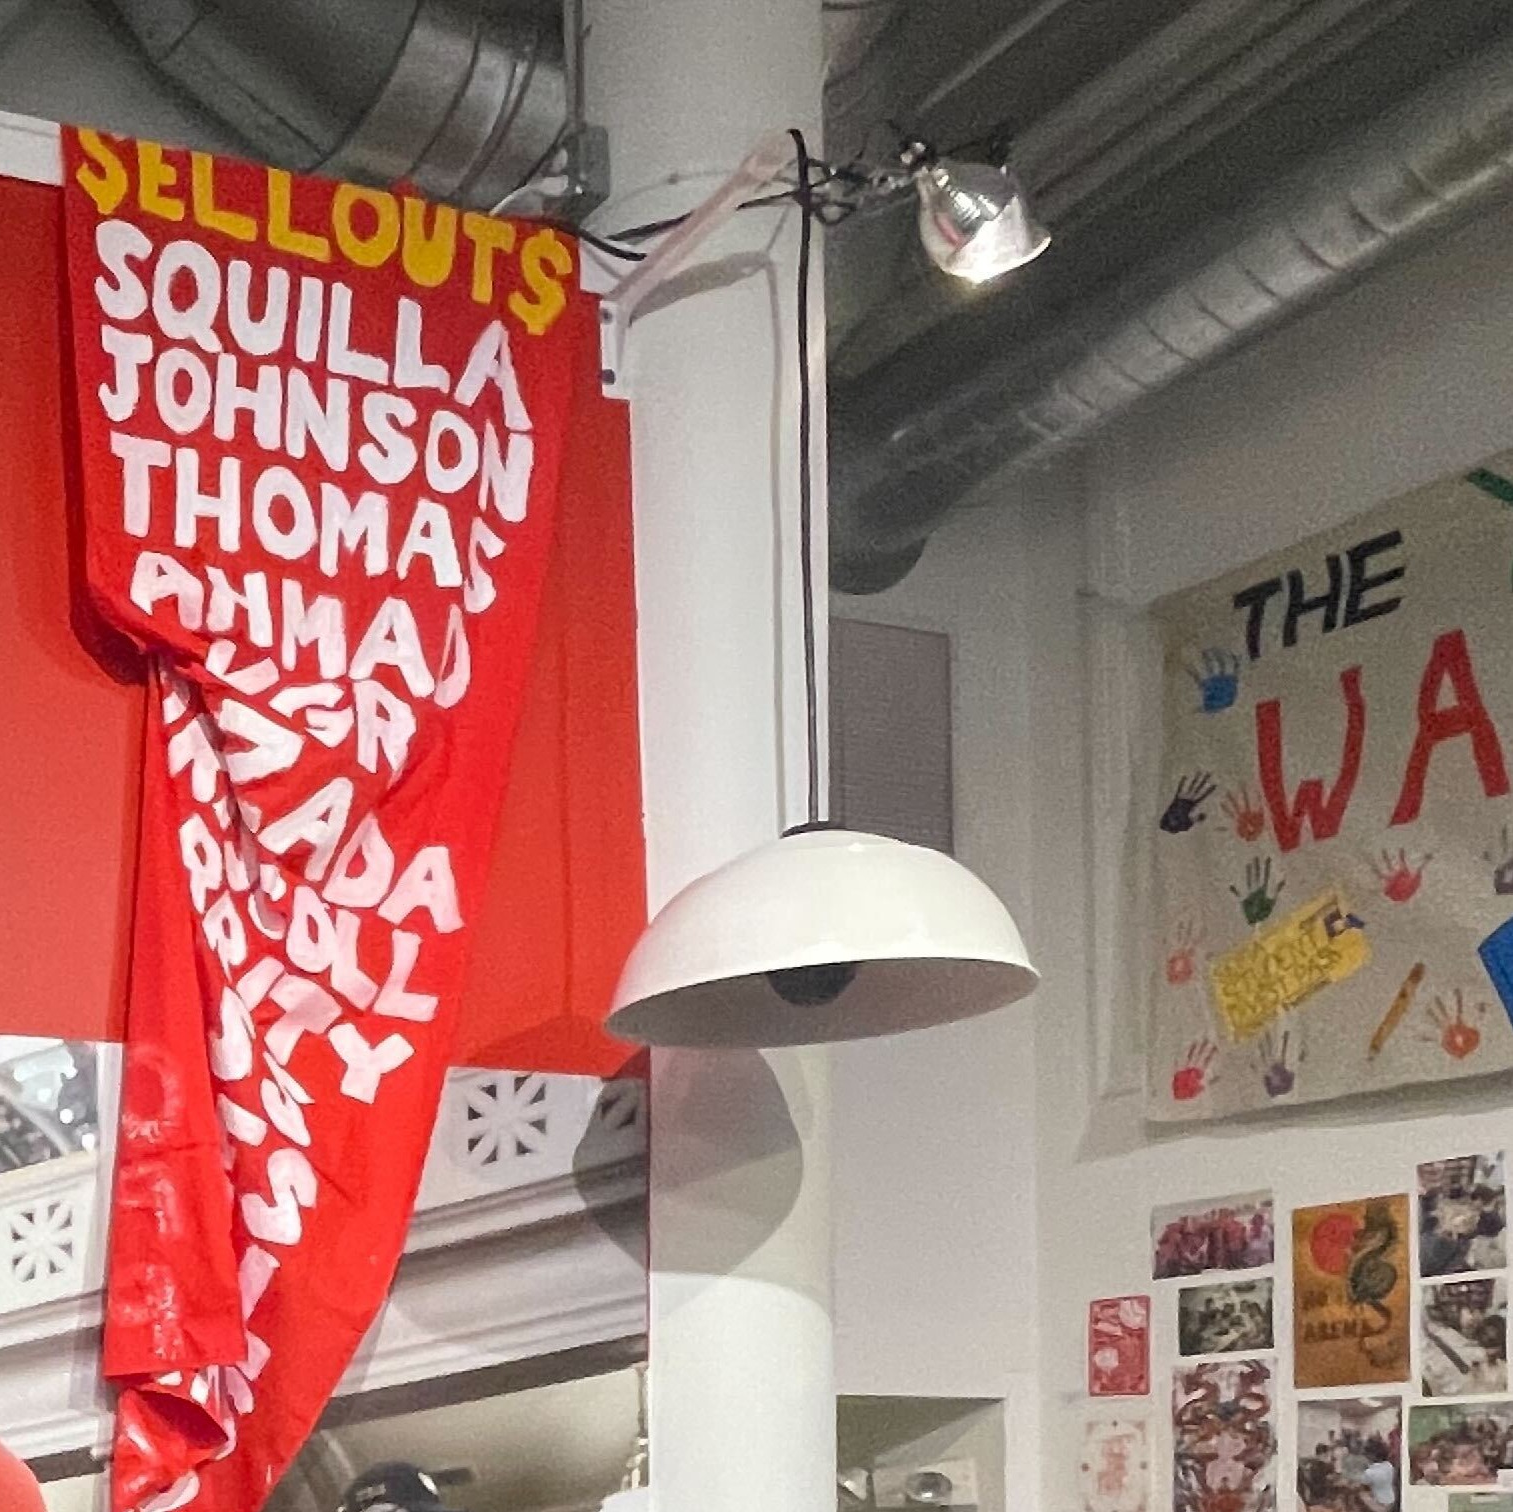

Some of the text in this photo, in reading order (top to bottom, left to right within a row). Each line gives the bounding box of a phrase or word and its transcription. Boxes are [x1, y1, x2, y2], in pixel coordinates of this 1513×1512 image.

[95, 218, 533, 432] SQUILLA
[98, 324, 534, 523] JOHNSON
[111, 431, 507, 614] THOMAS
[1234, 529, 1405, 661] THE
